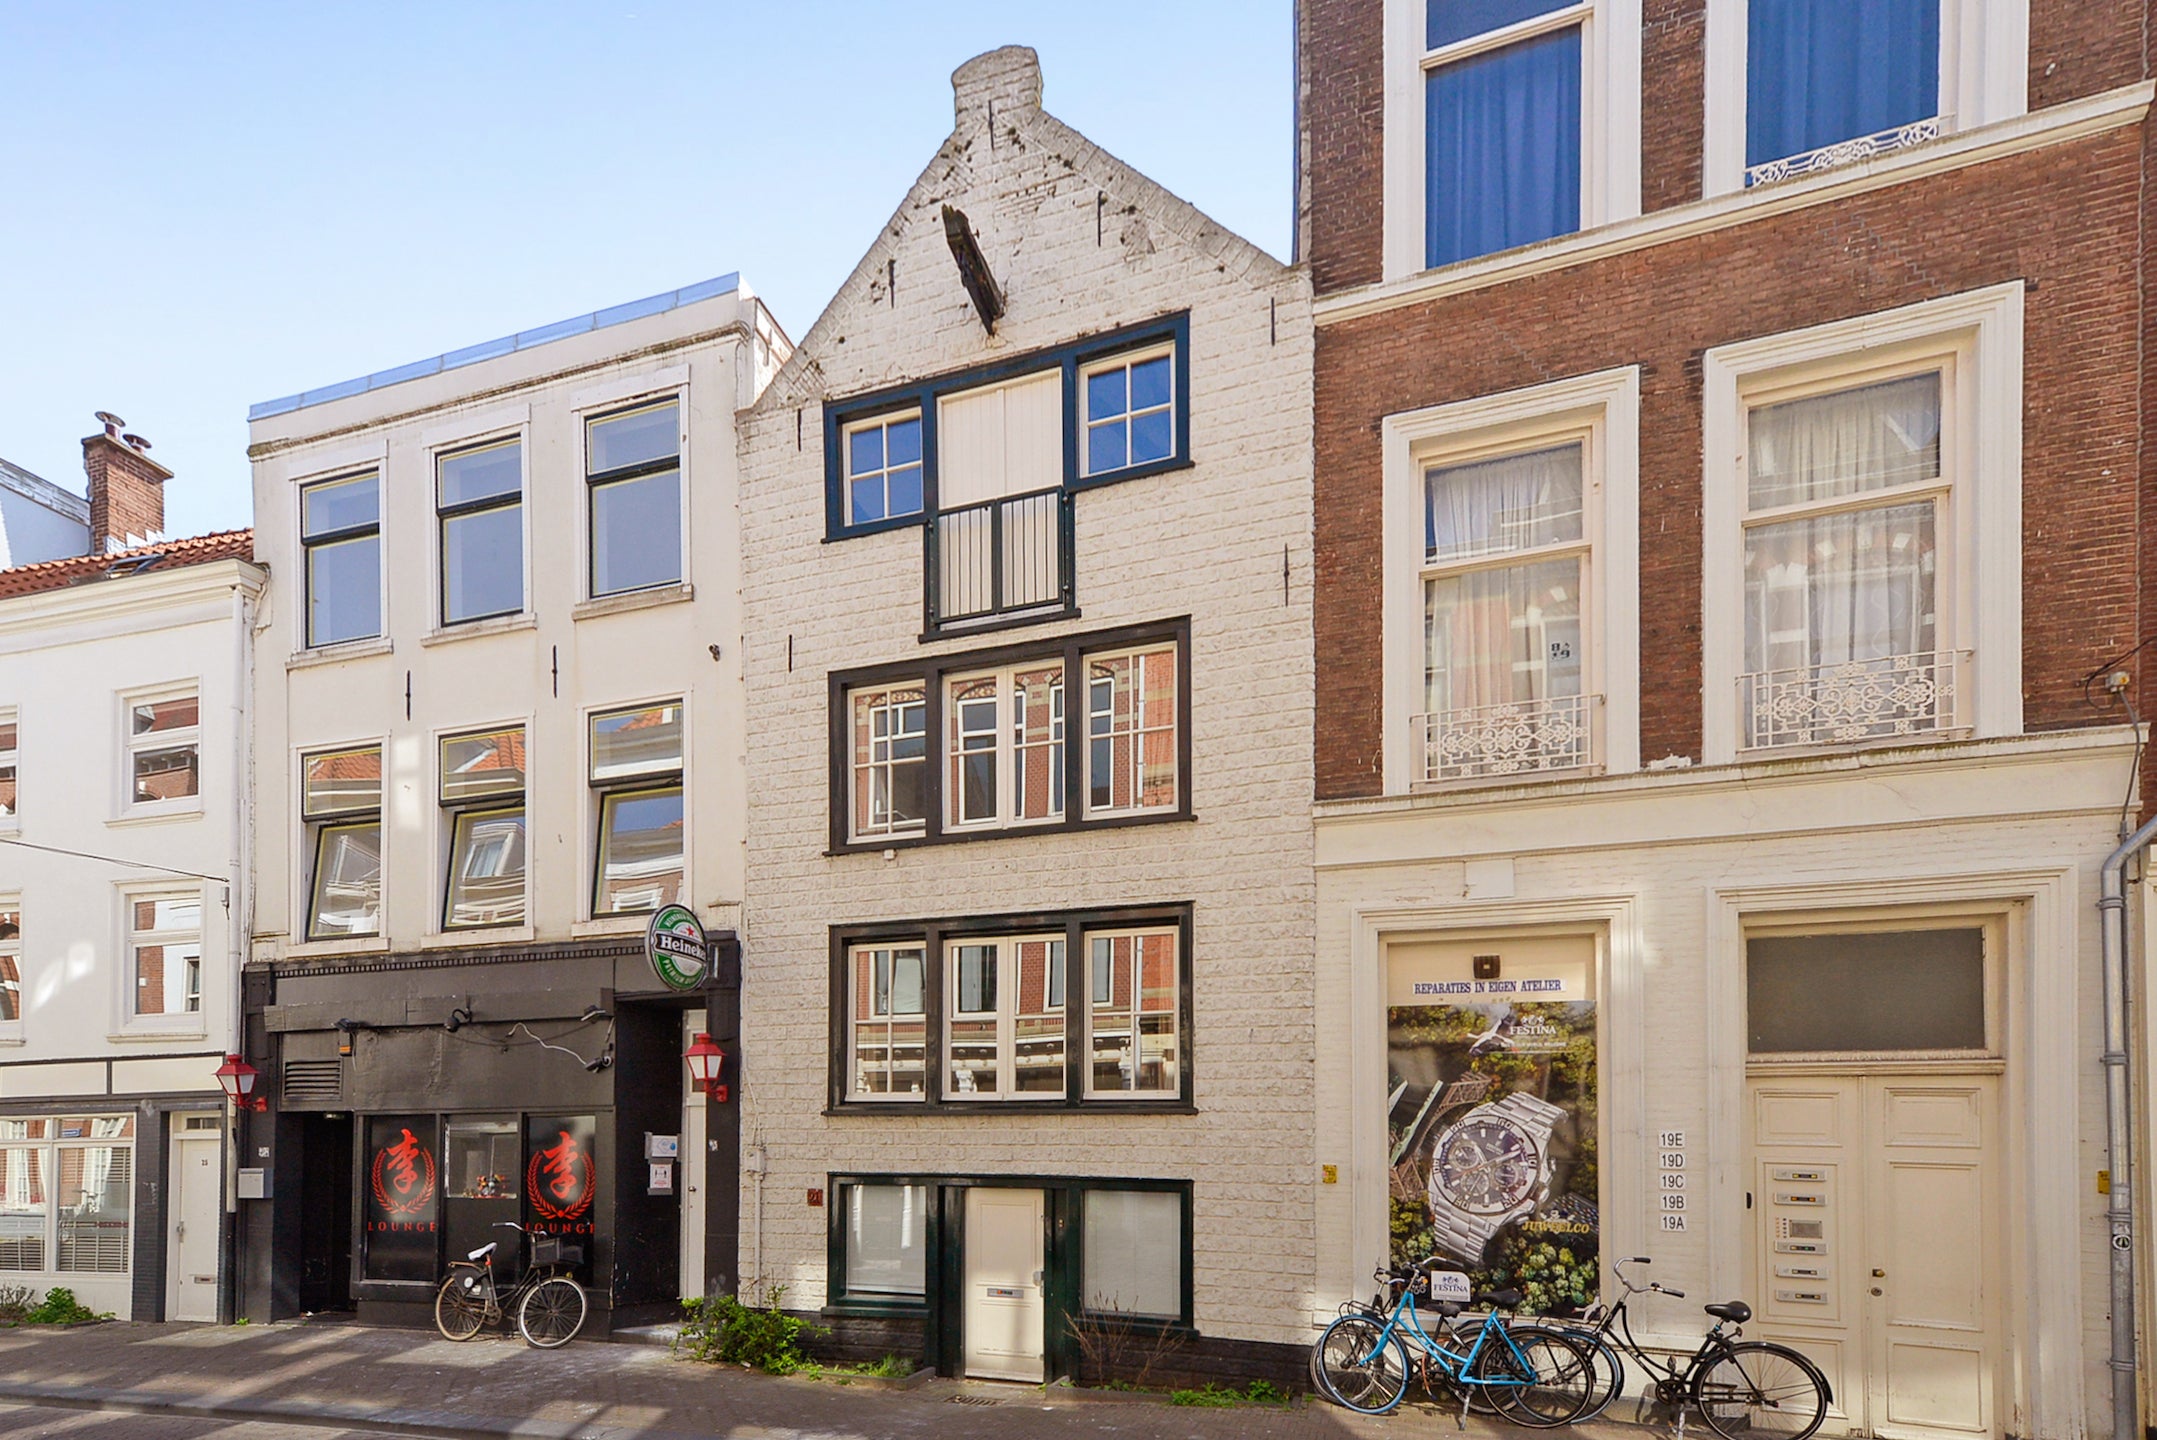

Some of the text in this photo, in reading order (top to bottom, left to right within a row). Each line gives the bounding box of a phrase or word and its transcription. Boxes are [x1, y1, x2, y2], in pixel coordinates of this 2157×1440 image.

[660, 935, 707, 959] Heineke
[1414, 979, 1562, 994] REPARATIES IN EIGEN ATELIER
[1510, 1025, 1556, 1036] FESTINA
[1661, 1133, 1683, 1146] 19E
[1662, 1154, 1684, 1167] 19D
[1662, 1175, 1684, 1188] 19C
[1662, 1195, 1684, 1209] 19B
[367, 1221, 437, 1232] LOUNGE
[1522, 1221, 1590, 1234] JUWEELCO
[1663, 1216, 1684, 1230] 19A
[1433, 1283, 1468, 1293] FESTINA
